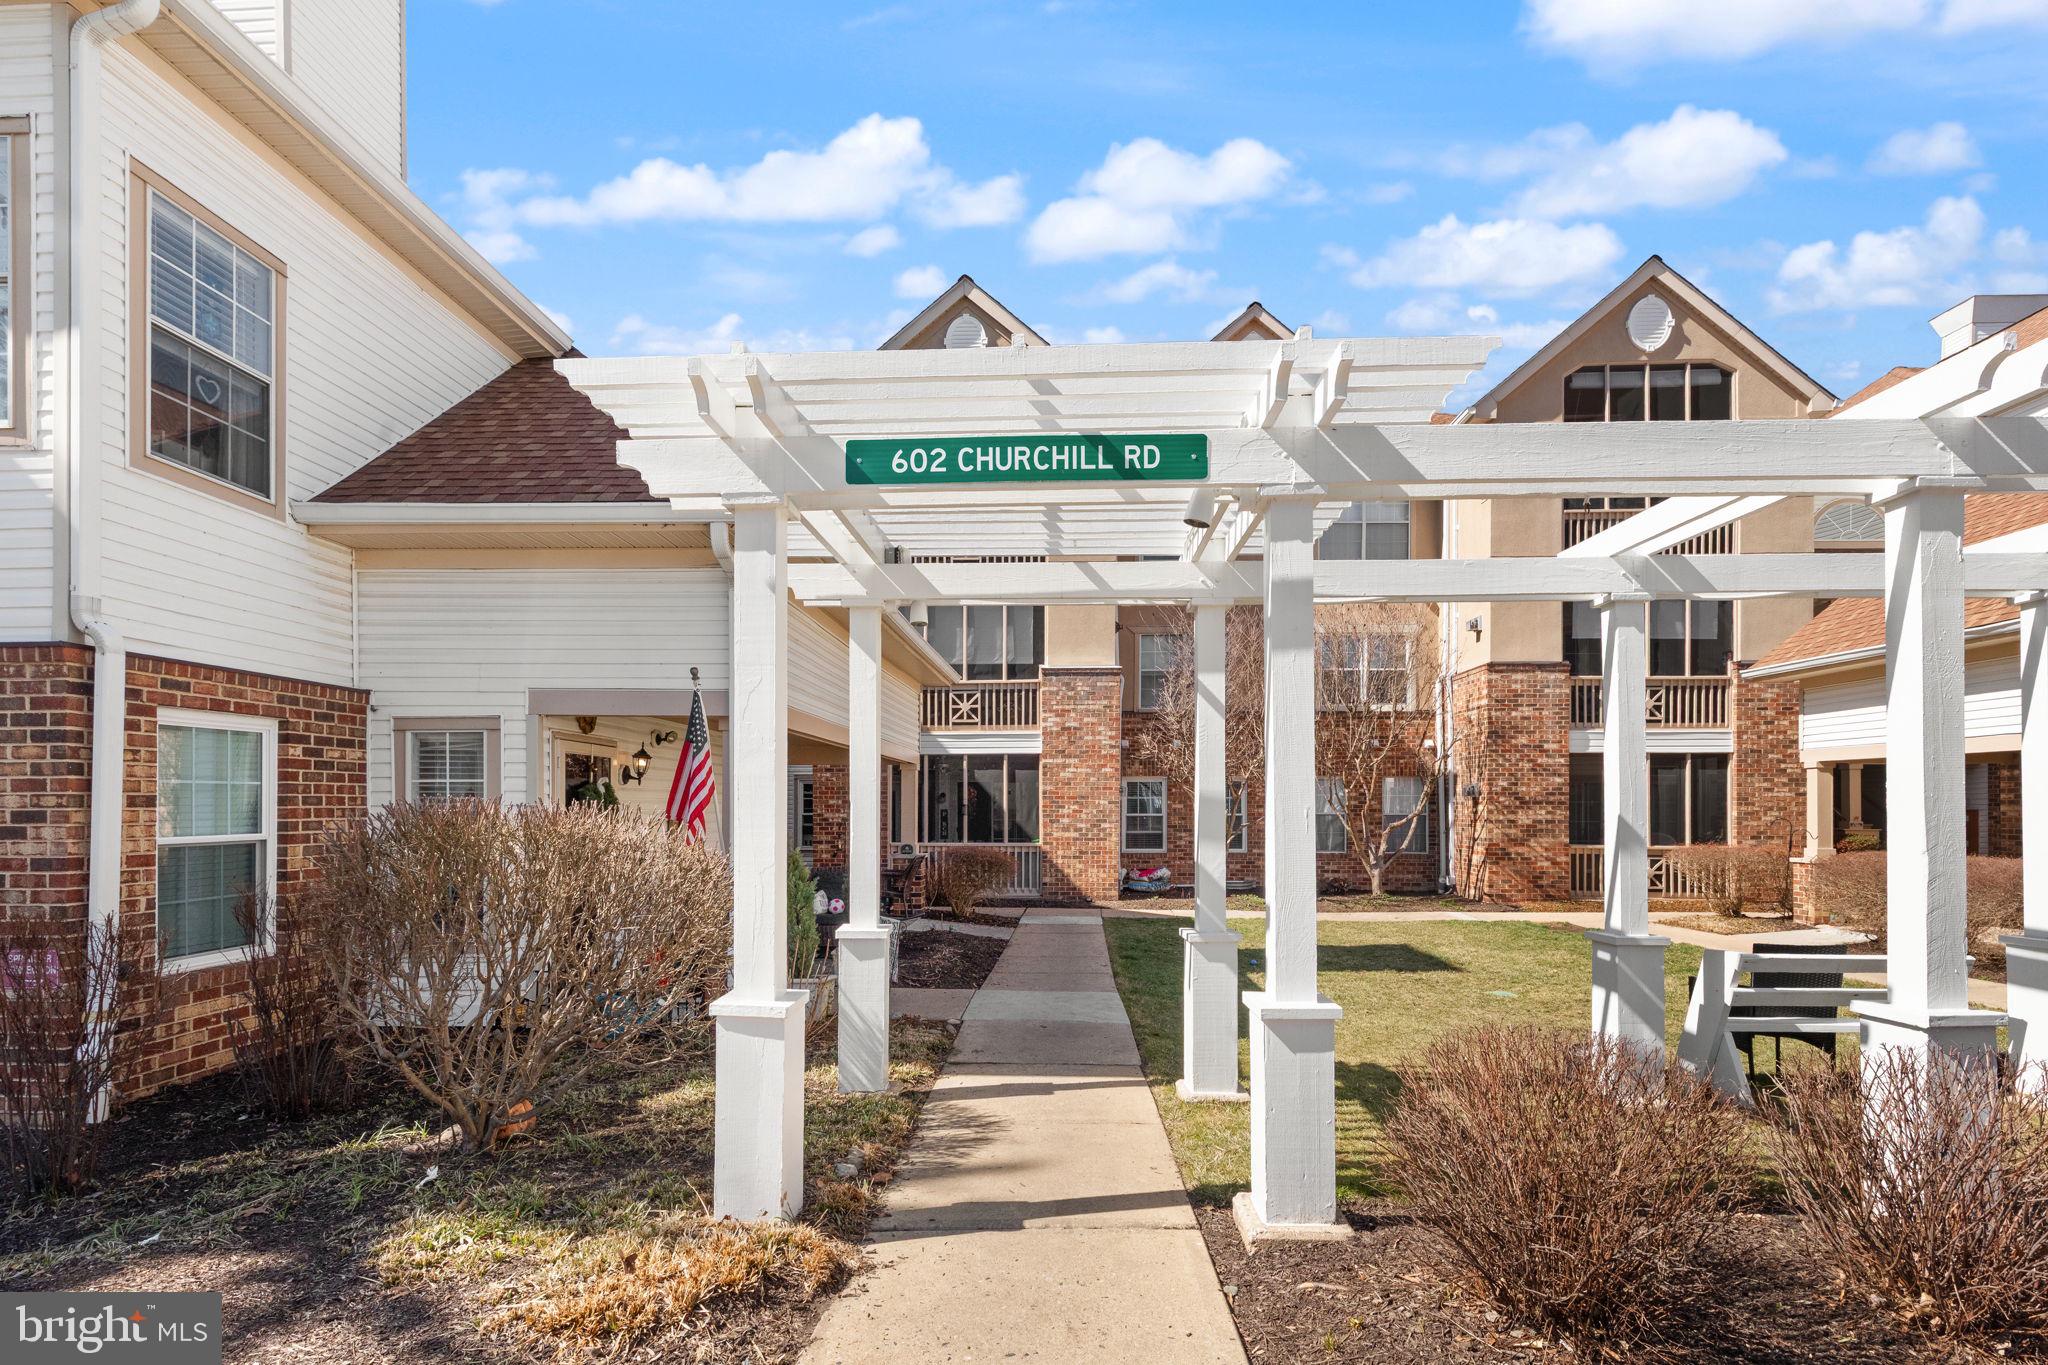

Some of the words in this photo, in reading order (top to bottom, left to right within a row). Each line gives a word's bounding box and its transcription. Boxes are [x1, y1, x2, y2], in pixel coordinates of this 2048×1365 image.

[891, 447, 947, 474] 602
[957, 445, 1114, 472] CHURCHILL
[1124, 444, 1161, 470] RD
